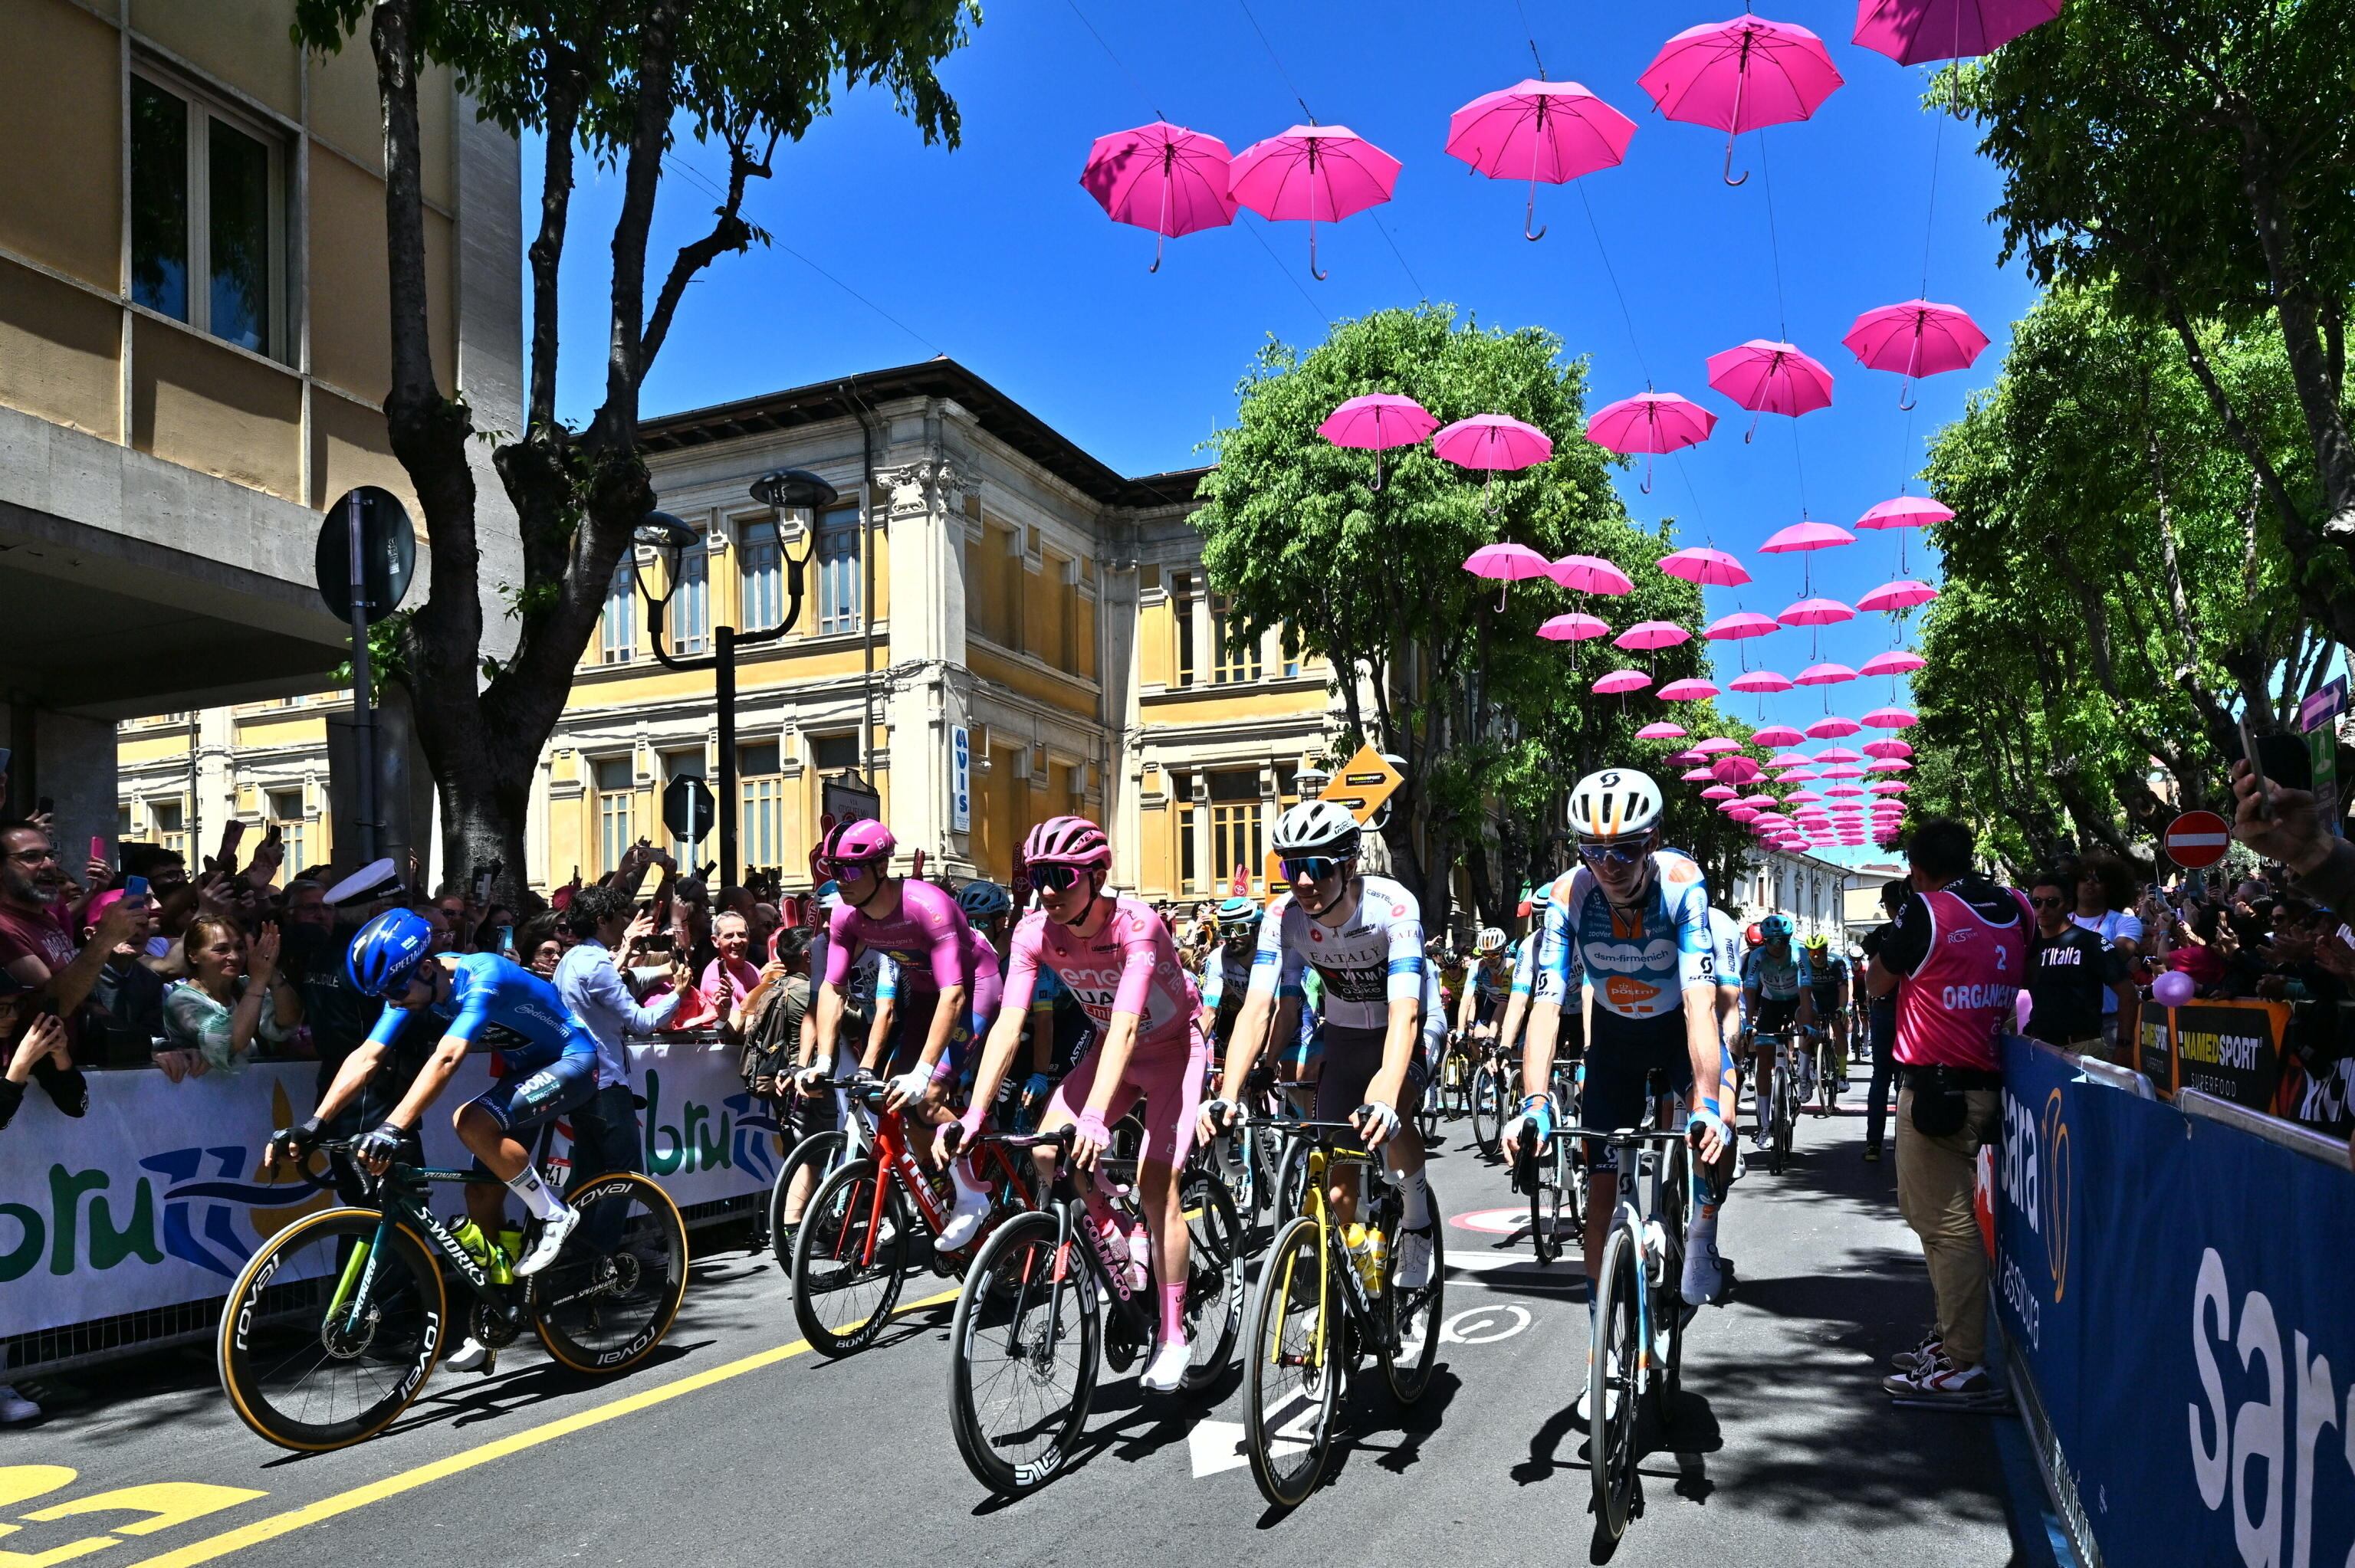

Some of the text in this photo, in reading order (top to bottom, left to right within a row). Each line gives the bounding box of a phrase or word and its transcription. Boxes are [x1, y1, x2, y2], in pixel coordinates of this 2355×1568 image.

[956, 730, 967, 812] AVIS
[1075, 830, 1094, 850] MET
[807, 906, 817, 927] YOTA
[1309, 945, 1381, 963] EATALY
[1595, 950, 1669, 963] dsm-firmenich
[1725, 938, 1736, 973] MERIDA
[1948, 933, 1966, 944] RCS
[1995, 945, 2006, 970] 2
[1074, 989, 1115, 1005] UA
[518, 1005, 570, 1038] mediolanum
[1069, 1029, 1090, 1068] ASTANA
[2183, 1032, 2258, 1071] NAMEDSPORT
[515, 1071, 557, 1096] BORA
[2191, 1072, 2237, 1098] SUPERFOOD
[2001, 1087, 2038, 1235] sara
[902, 1152, 945, 1215] TREK
[414, 1206, 485, 1288] S-WORKS
[1082, 1215, 1131, 1301] COLNAGO
[237, 1253, 281, 1351] roval
[836, 1269, 901, 1349] BONTRAGER
[401, 1311, 439, 1402] roval
[597, 1326, 656, 1366] roval
[2189, 1247, 2355, 1568] sar
